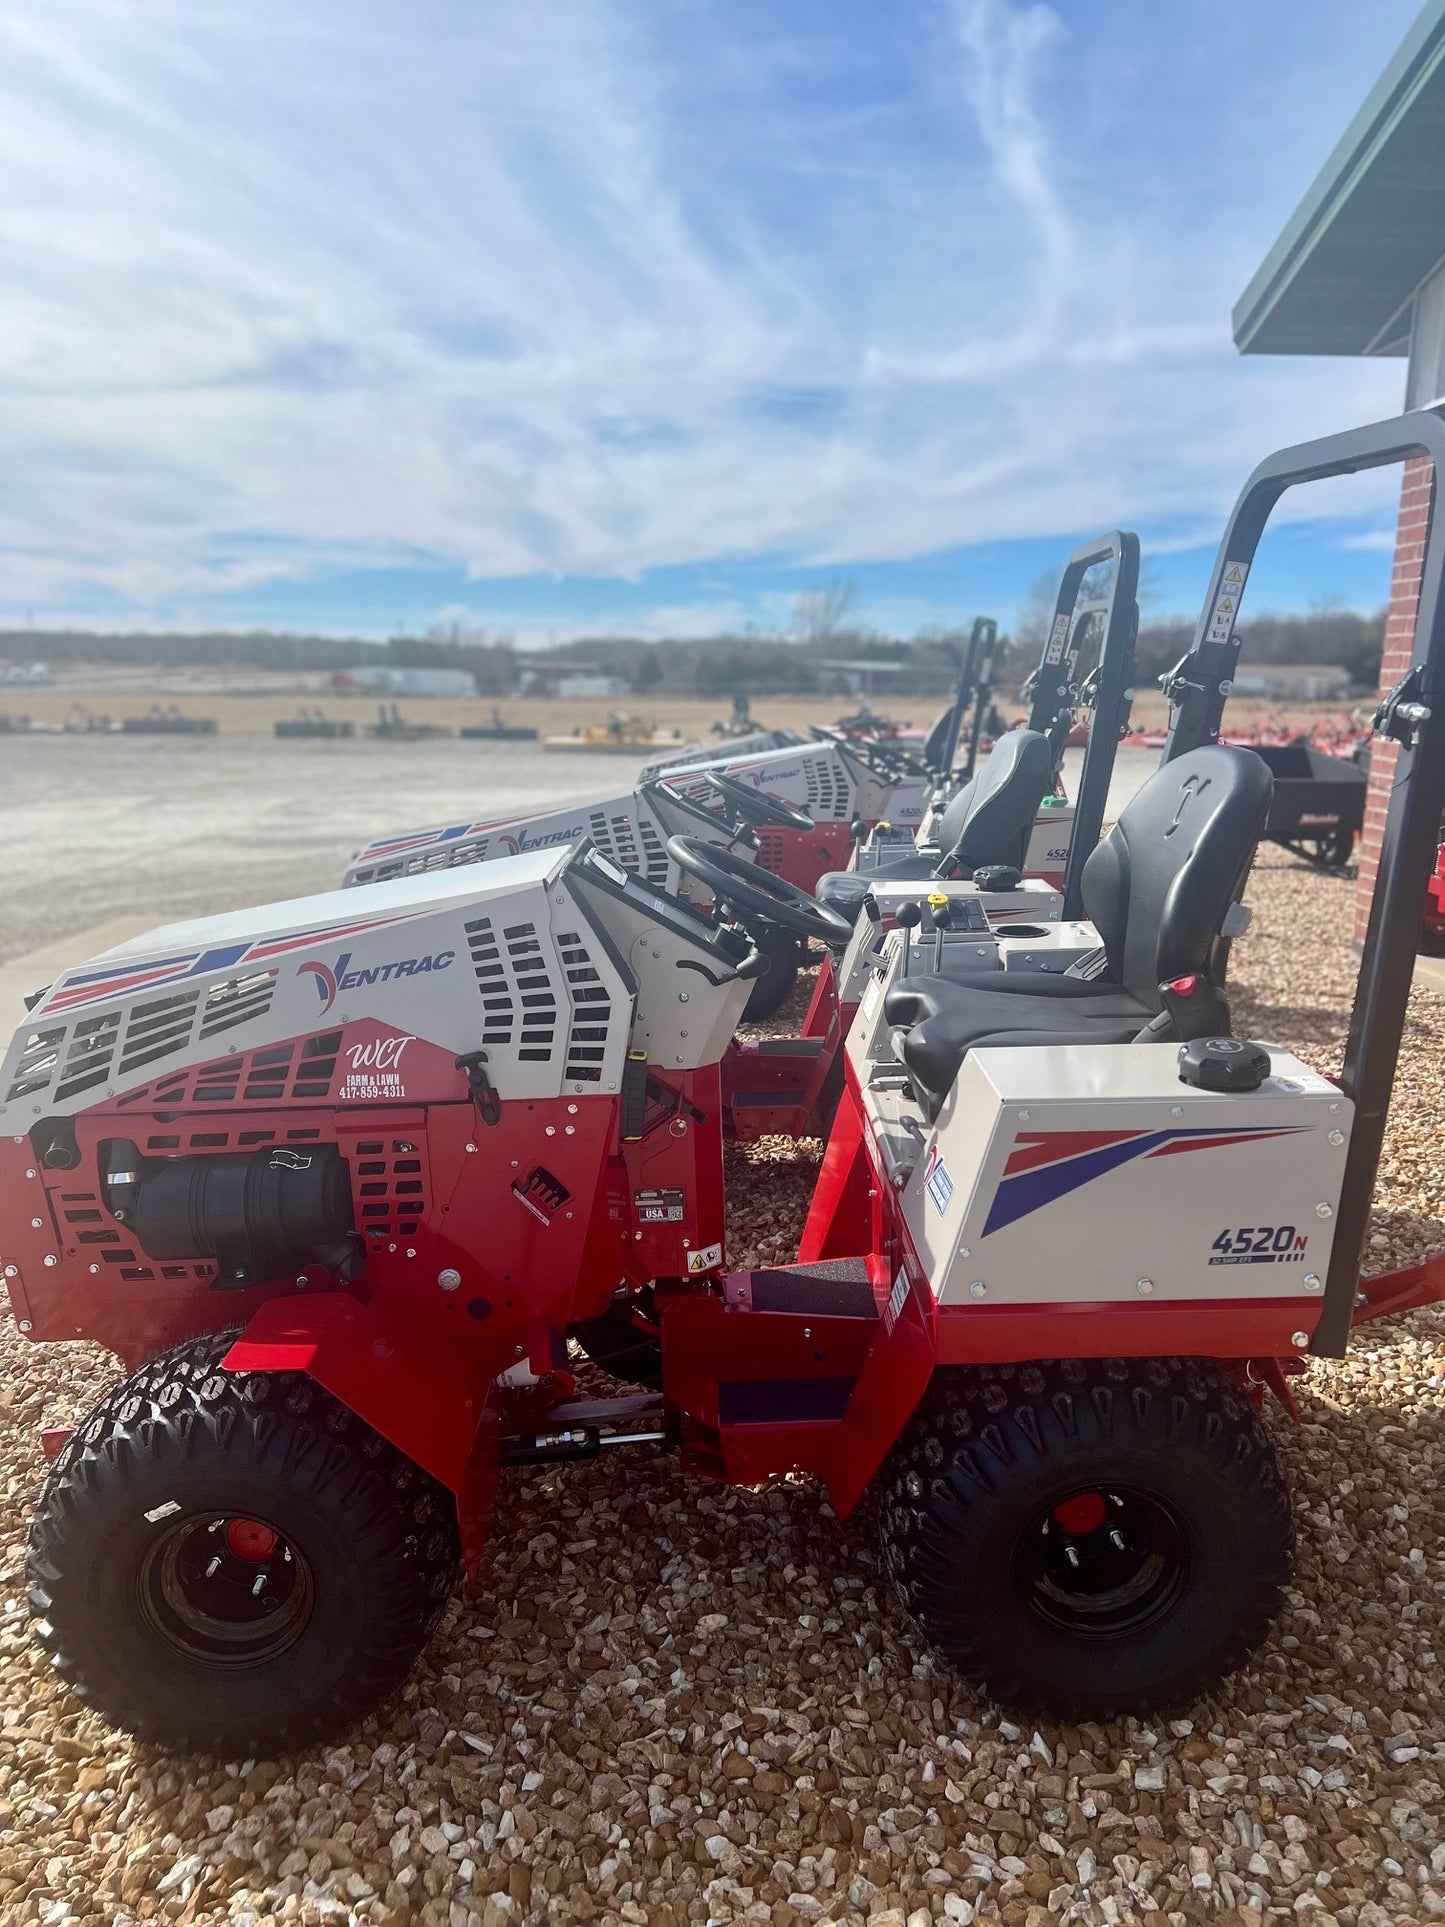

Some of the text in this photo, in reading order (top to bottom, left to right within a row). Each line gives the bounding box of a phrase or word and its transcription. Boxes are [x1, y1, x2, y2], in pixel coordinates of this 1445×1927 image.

[747, 769, 800, 789] VENTRAC
[498, 826, 583, 856] VENTRAC
[1047, 848, 1069, 858] 452
[296, 951, 455, 1017] VENTRAC
[345, 1036, 416, 1069] WCT
[346, 1074, 400, 1086] FARM & LAWN
[646, 1209, 664, 1218] USA
